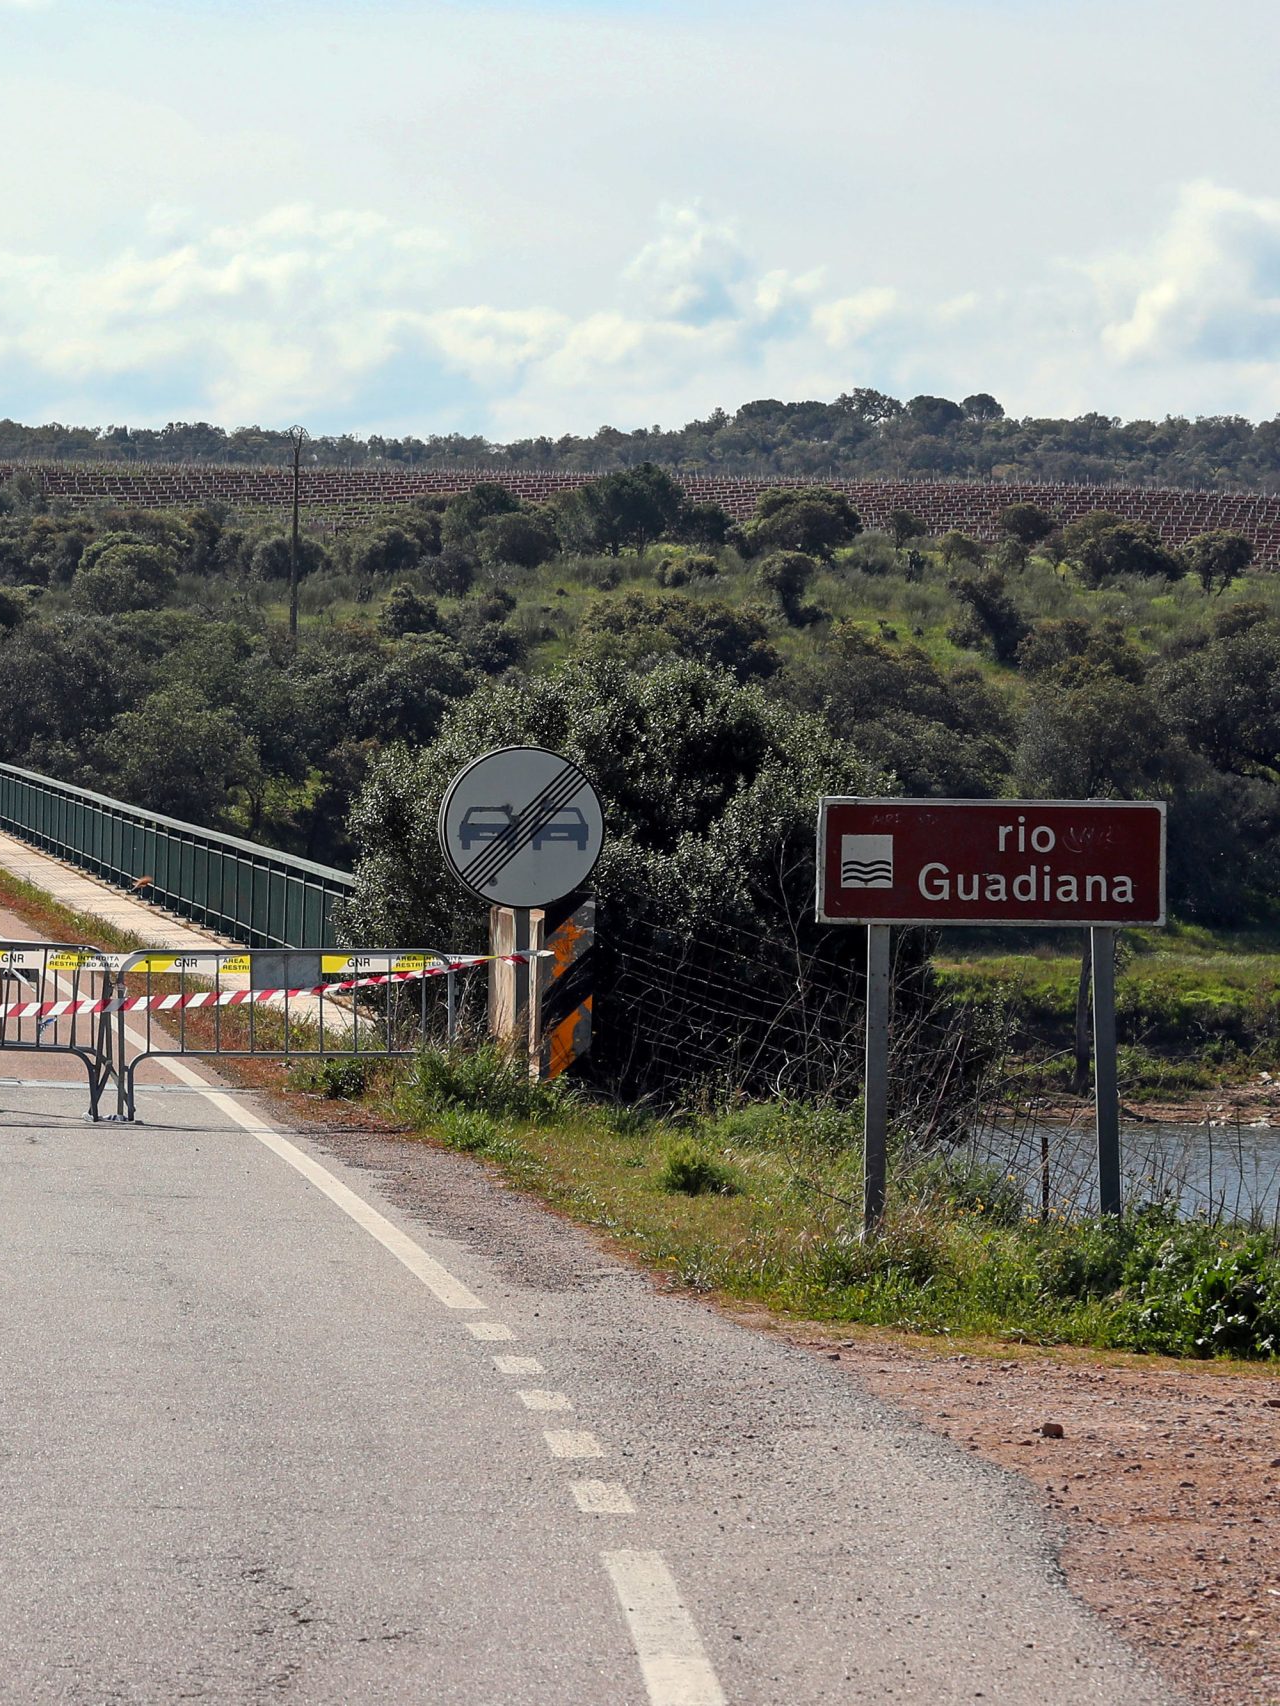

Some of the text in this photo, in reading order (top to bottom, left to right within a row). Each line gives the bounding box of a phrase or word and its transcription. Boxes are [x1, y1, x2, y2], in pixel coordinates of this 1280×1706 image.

[998, 816, 1056, 853] rio
[918, 862, 1135, 903] Guadiana
[1, 953, 24, 963] GNR
[174, 958, 198, 968] GNR
[346, 958, 371, 967] GNR
